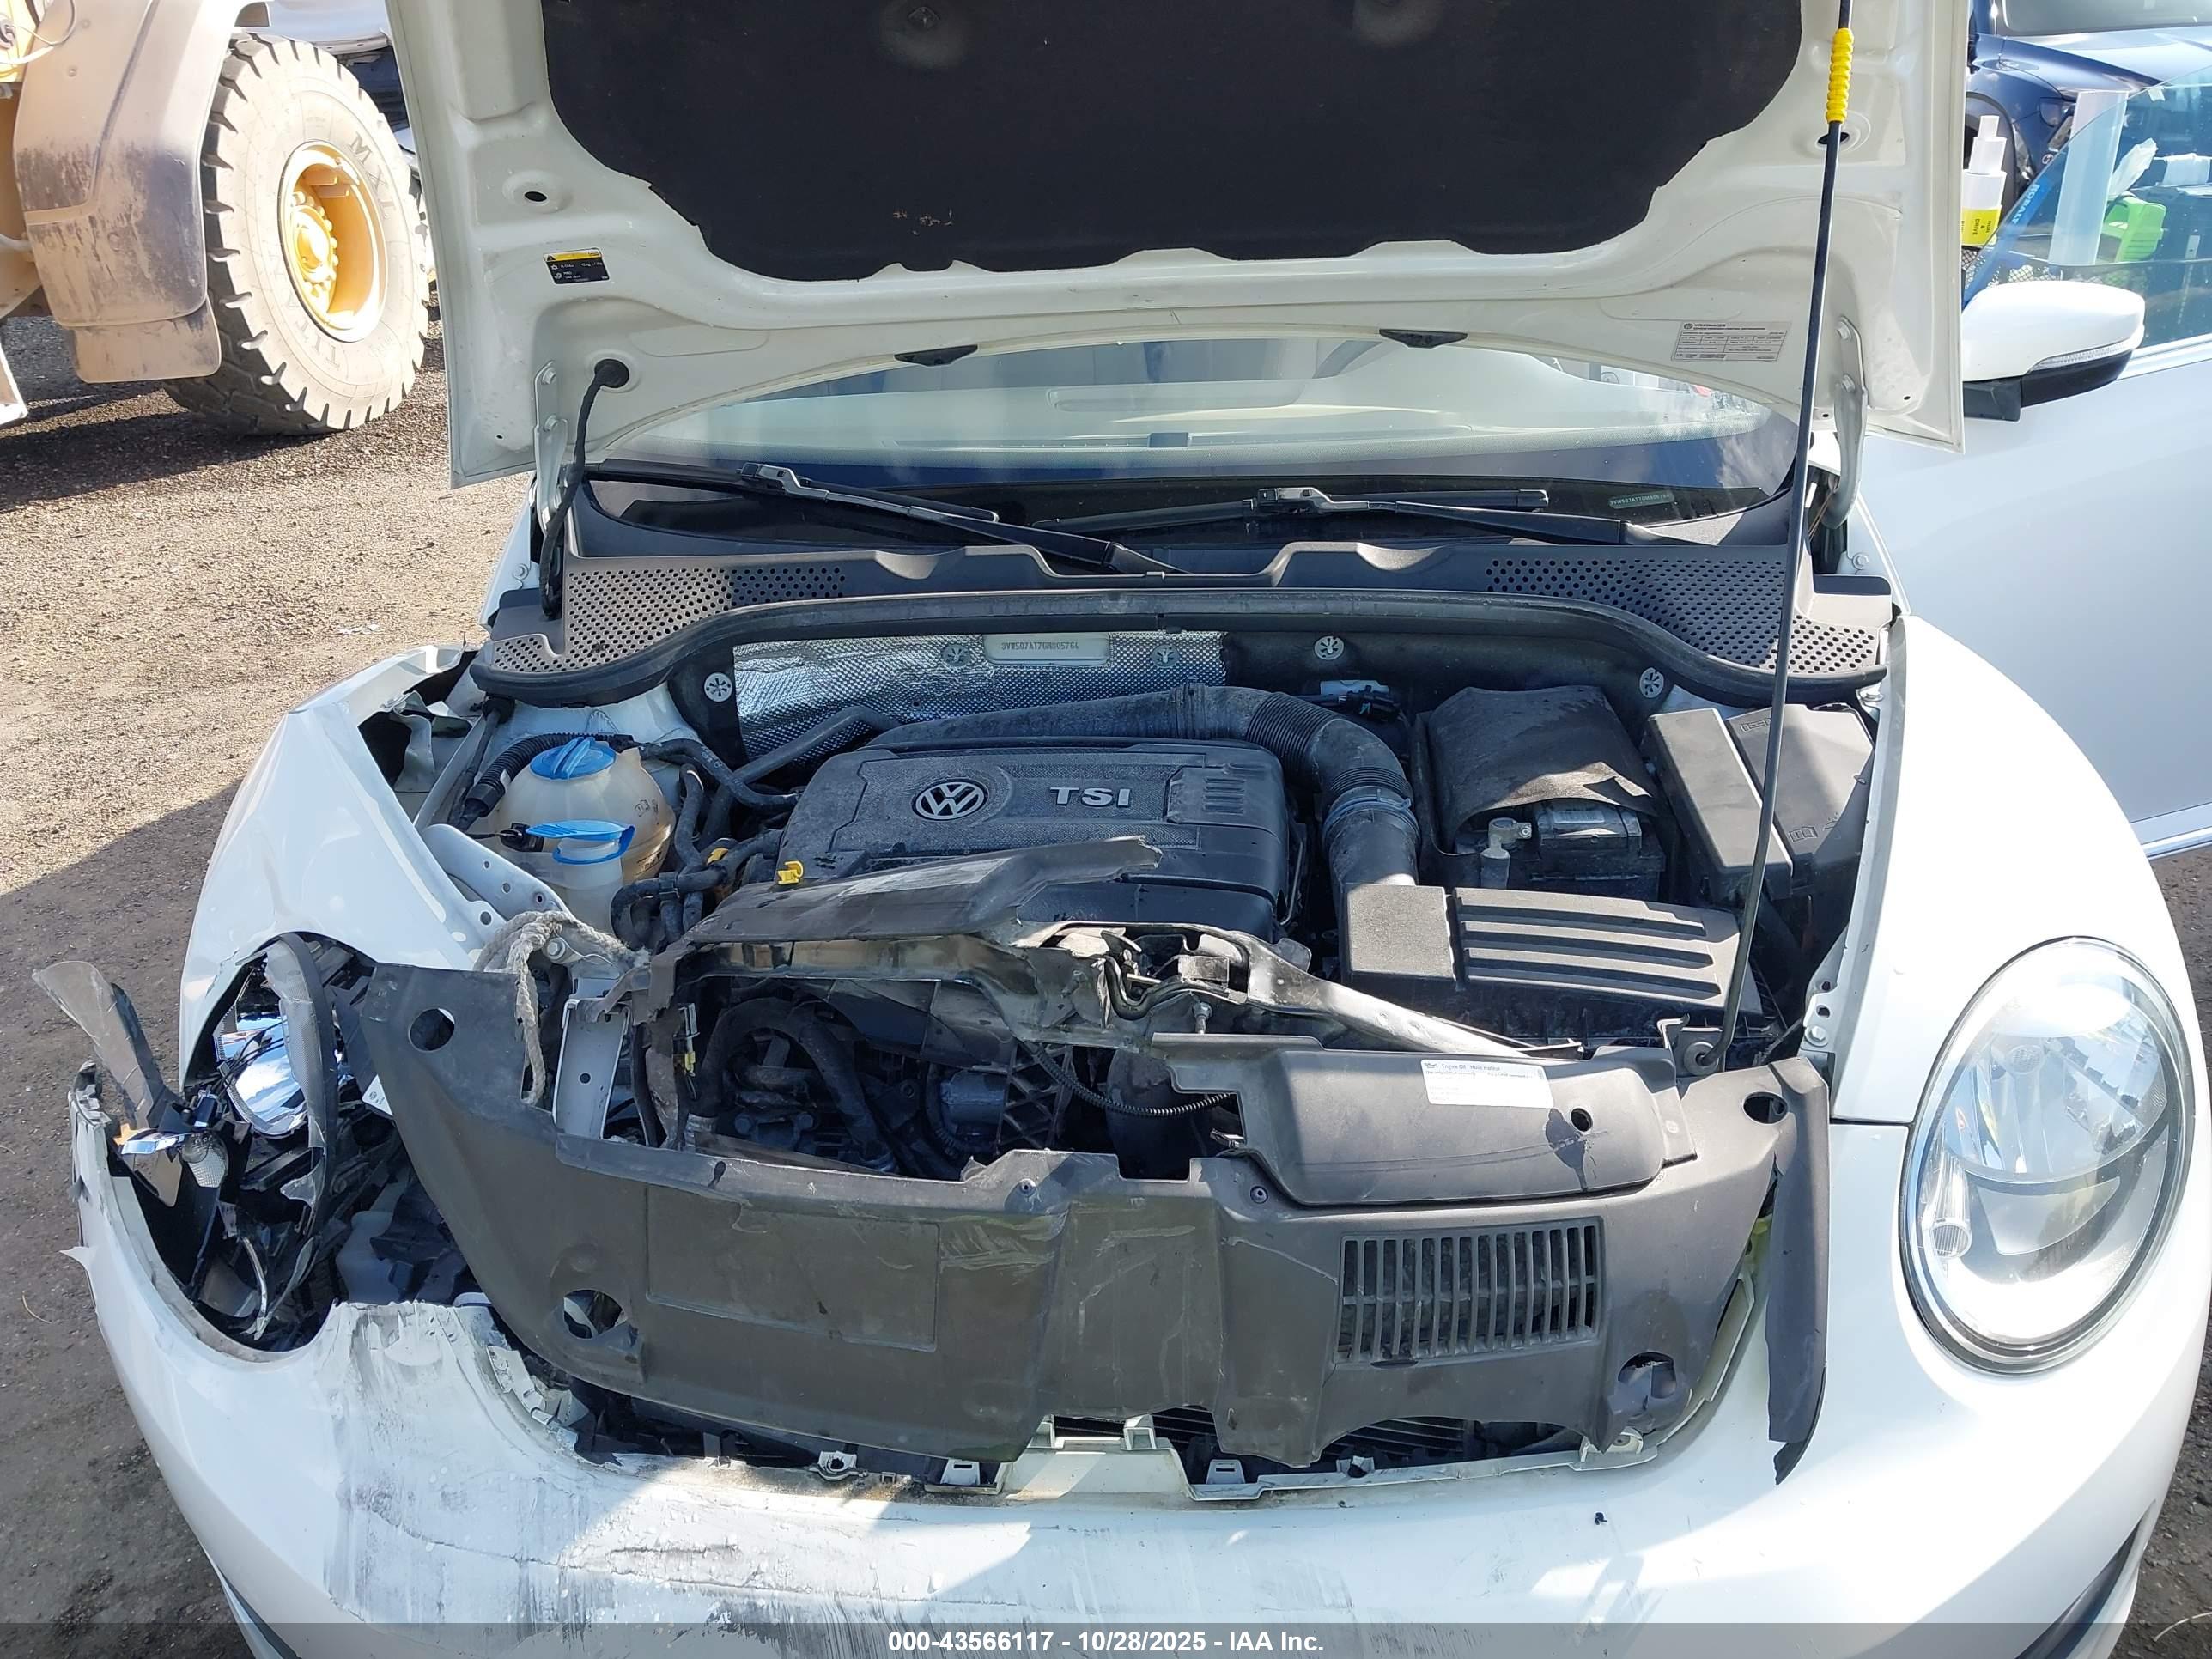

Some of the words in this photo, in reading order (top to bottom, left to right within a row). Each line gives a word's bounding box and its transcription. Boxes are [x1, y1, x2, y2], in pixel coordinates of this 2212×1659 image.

[2012, 184, 2040, 224] KOBALT
[1972, 218, 1980, 235] DRIVE
[1050, 787, 1131, 807] TSI
